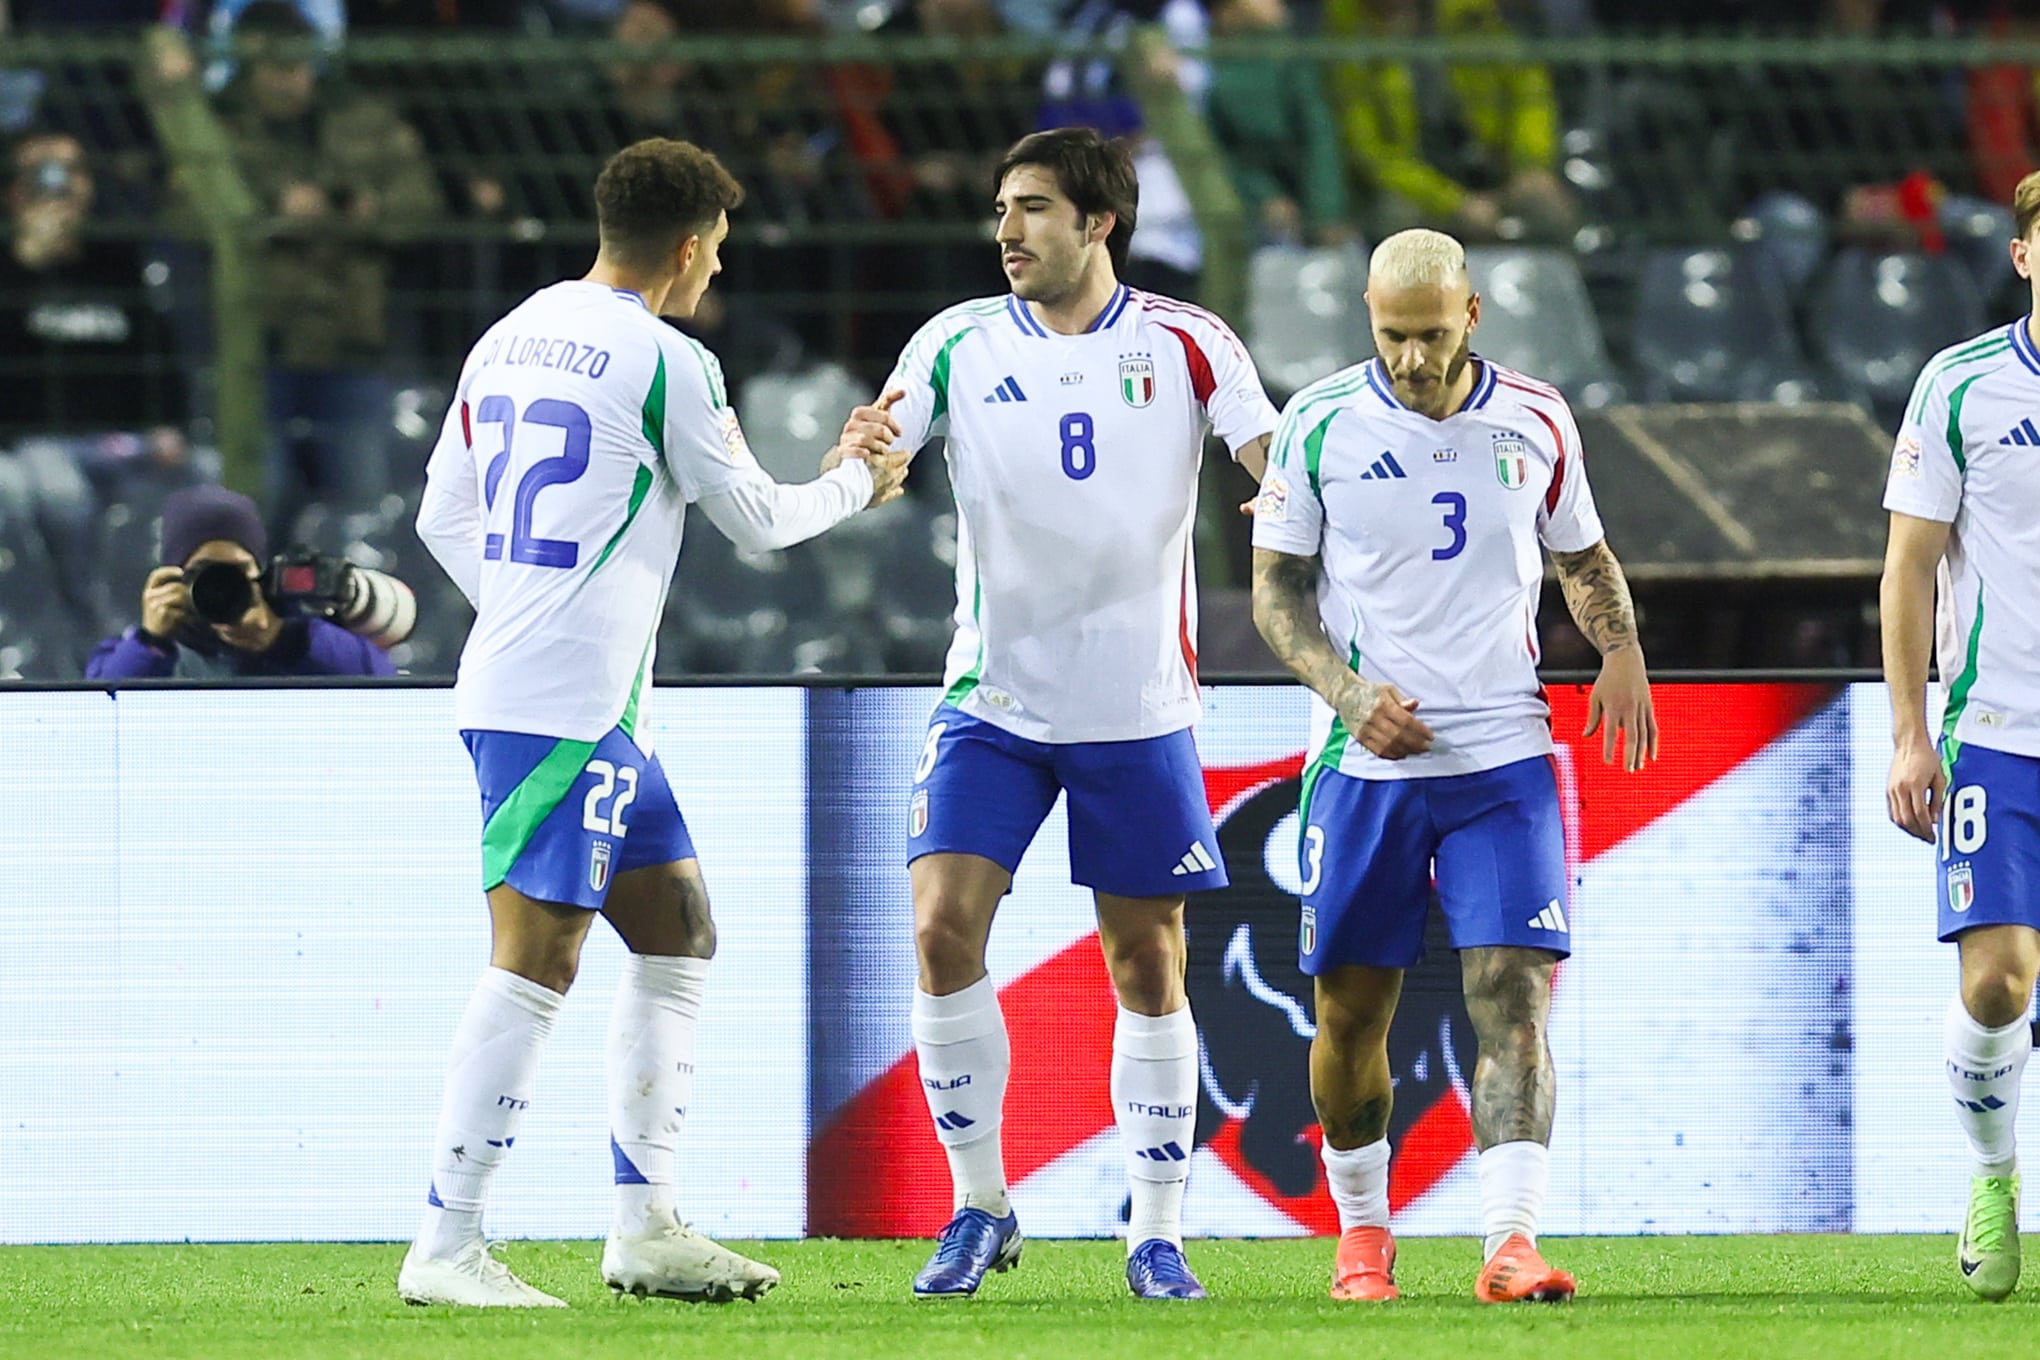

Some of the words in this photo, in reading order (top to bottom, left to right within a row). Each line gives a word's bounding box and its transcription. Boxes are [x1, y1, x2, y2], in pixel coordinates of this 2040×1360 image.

[505, 336, 610, 379] LORENZO
[1122, 364, 1151, 374] ITALIA
[1059, 412, 1096, 481] 8
[477, 395, 592, 569] 22
[1431, 491, 1468, 561] 3
[914, 722, 948, 785] 8
[583, 759, 639, 838] 22
[1942, 784, 1987, 862] 18
[1302, 825, 1326, 896] 3
[924, 1074, 972, 1090] ALIA
[1129, 1101, 1193, 1119] ITALIA
